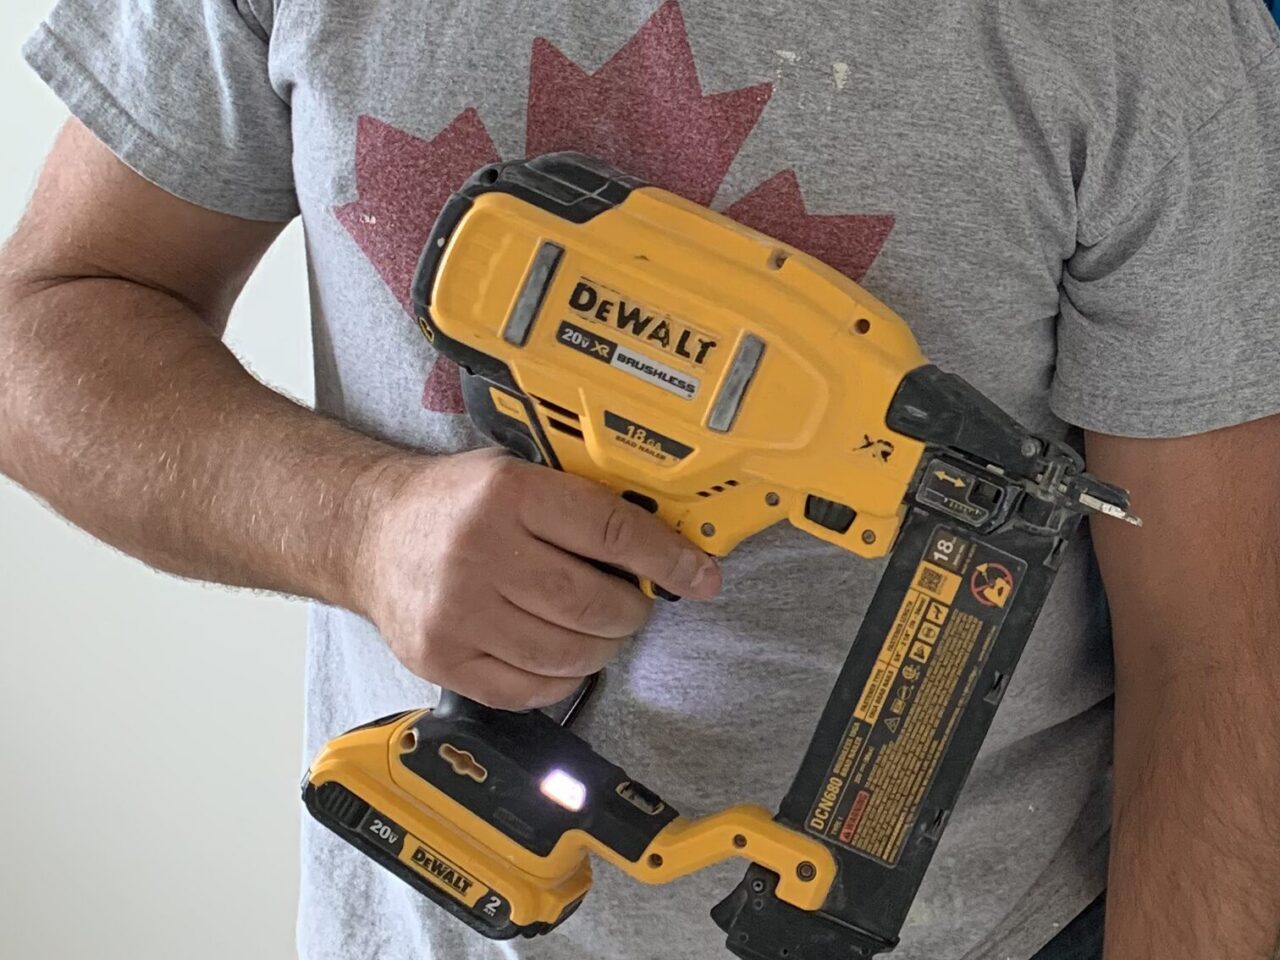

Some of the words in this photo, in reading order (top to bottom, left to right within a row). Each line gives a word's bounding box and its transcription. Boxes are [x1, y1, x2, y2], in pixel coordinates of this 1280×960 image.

[568, 281, 716, 364] DEWALT
[592, 341, 610, 359] XR
[616, 353, 696, 395] BRUSHLESS
[615, 435, 637, 449] BRAD
[637, 444, 666, 461] NAILER
[625, 425, 646, 443] 18
[647, 438, 663, 450] GA
[933, 538, 953, 562] 18
[872, 668, 882, 682] TYPE
[810, 777, 843, 829] DCN680
[412, 848, 473, 893] DEWALT
[485, 895, 501, 911] 2
